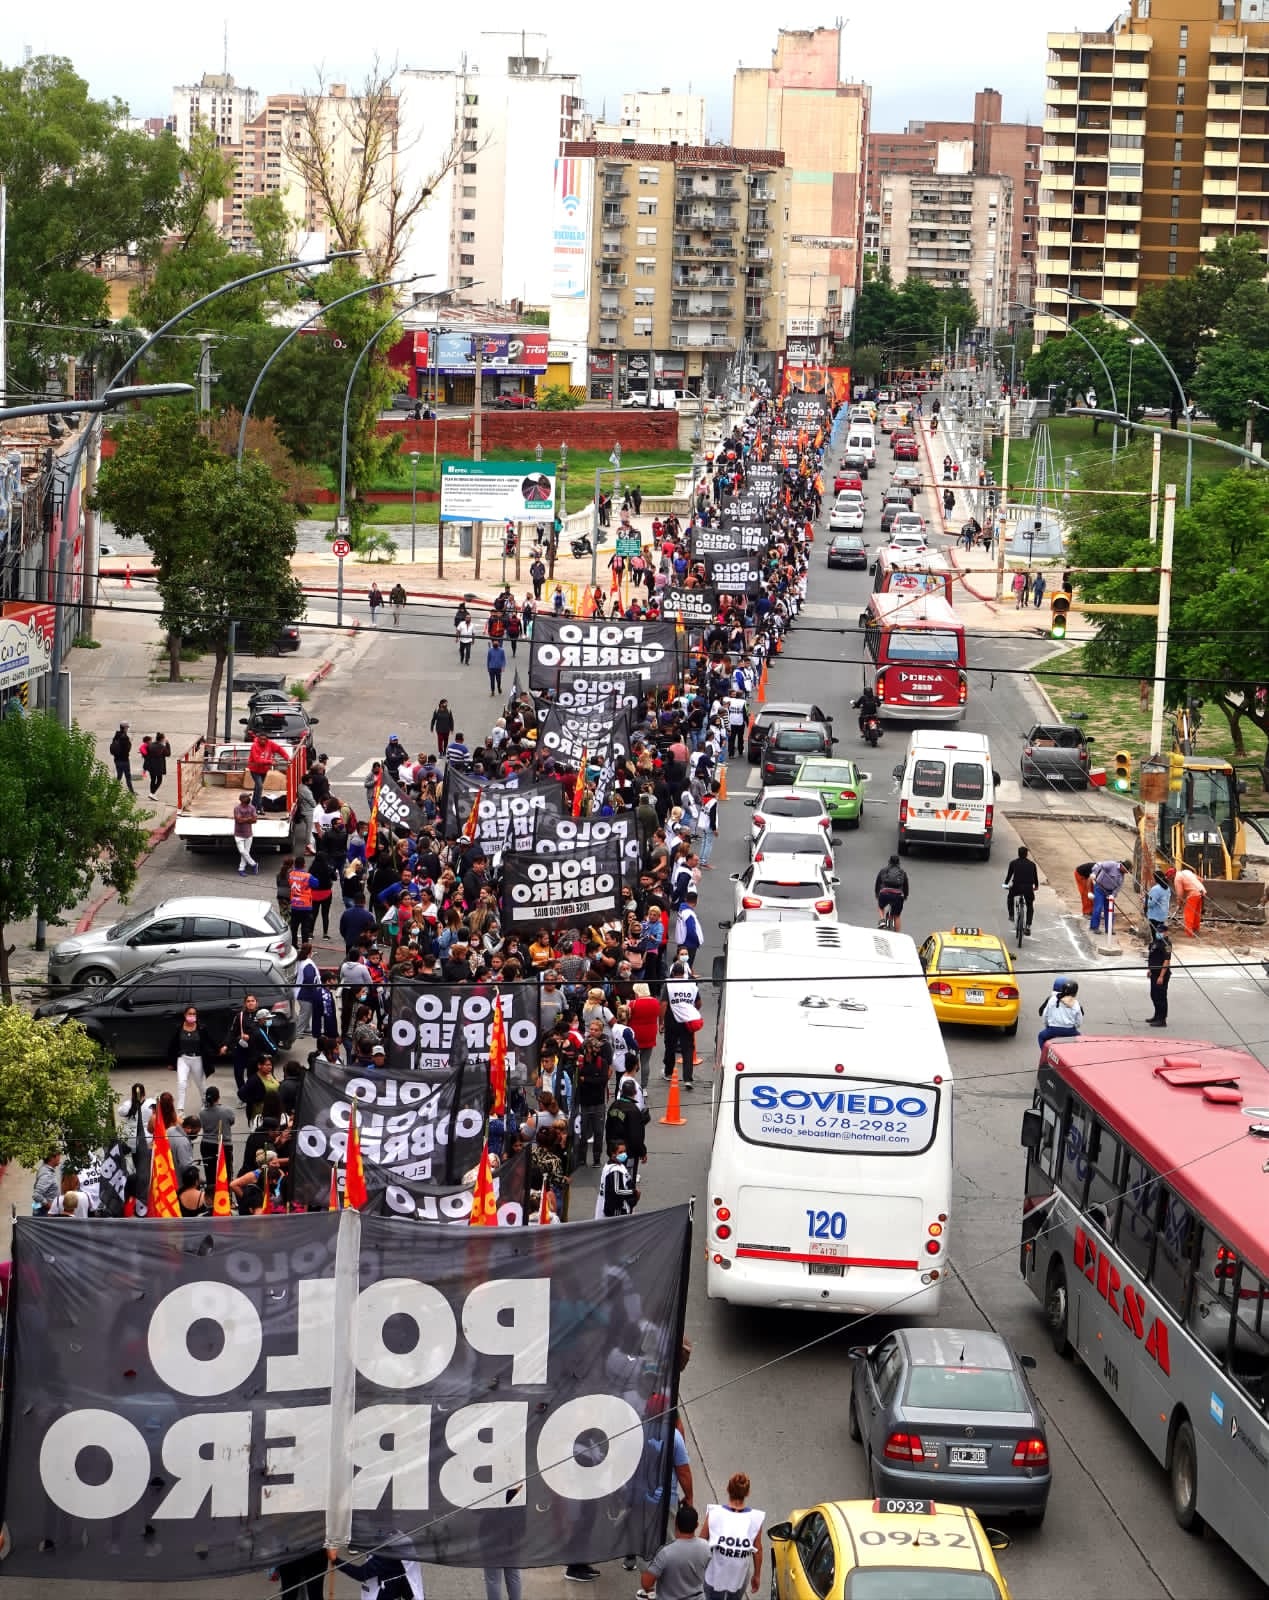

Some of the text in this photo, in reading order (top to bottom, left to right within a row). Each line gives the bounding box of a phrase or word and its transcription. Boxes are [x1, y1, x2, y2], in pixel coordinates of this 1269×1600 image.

[750, 1085, 928, 1118] SOVIEDO
[773, 1112, 908, 1133] 351 678-2982
[761, 1126, 910, 1144] oviedo_sebastian@hotmail.com
[806, 1210, 847, 1240] 120
[886, 1501, 924, 1513] 0932
[717, 1535, 751, 1548] POLO
[859, 1530, 971, 1549] 0932
